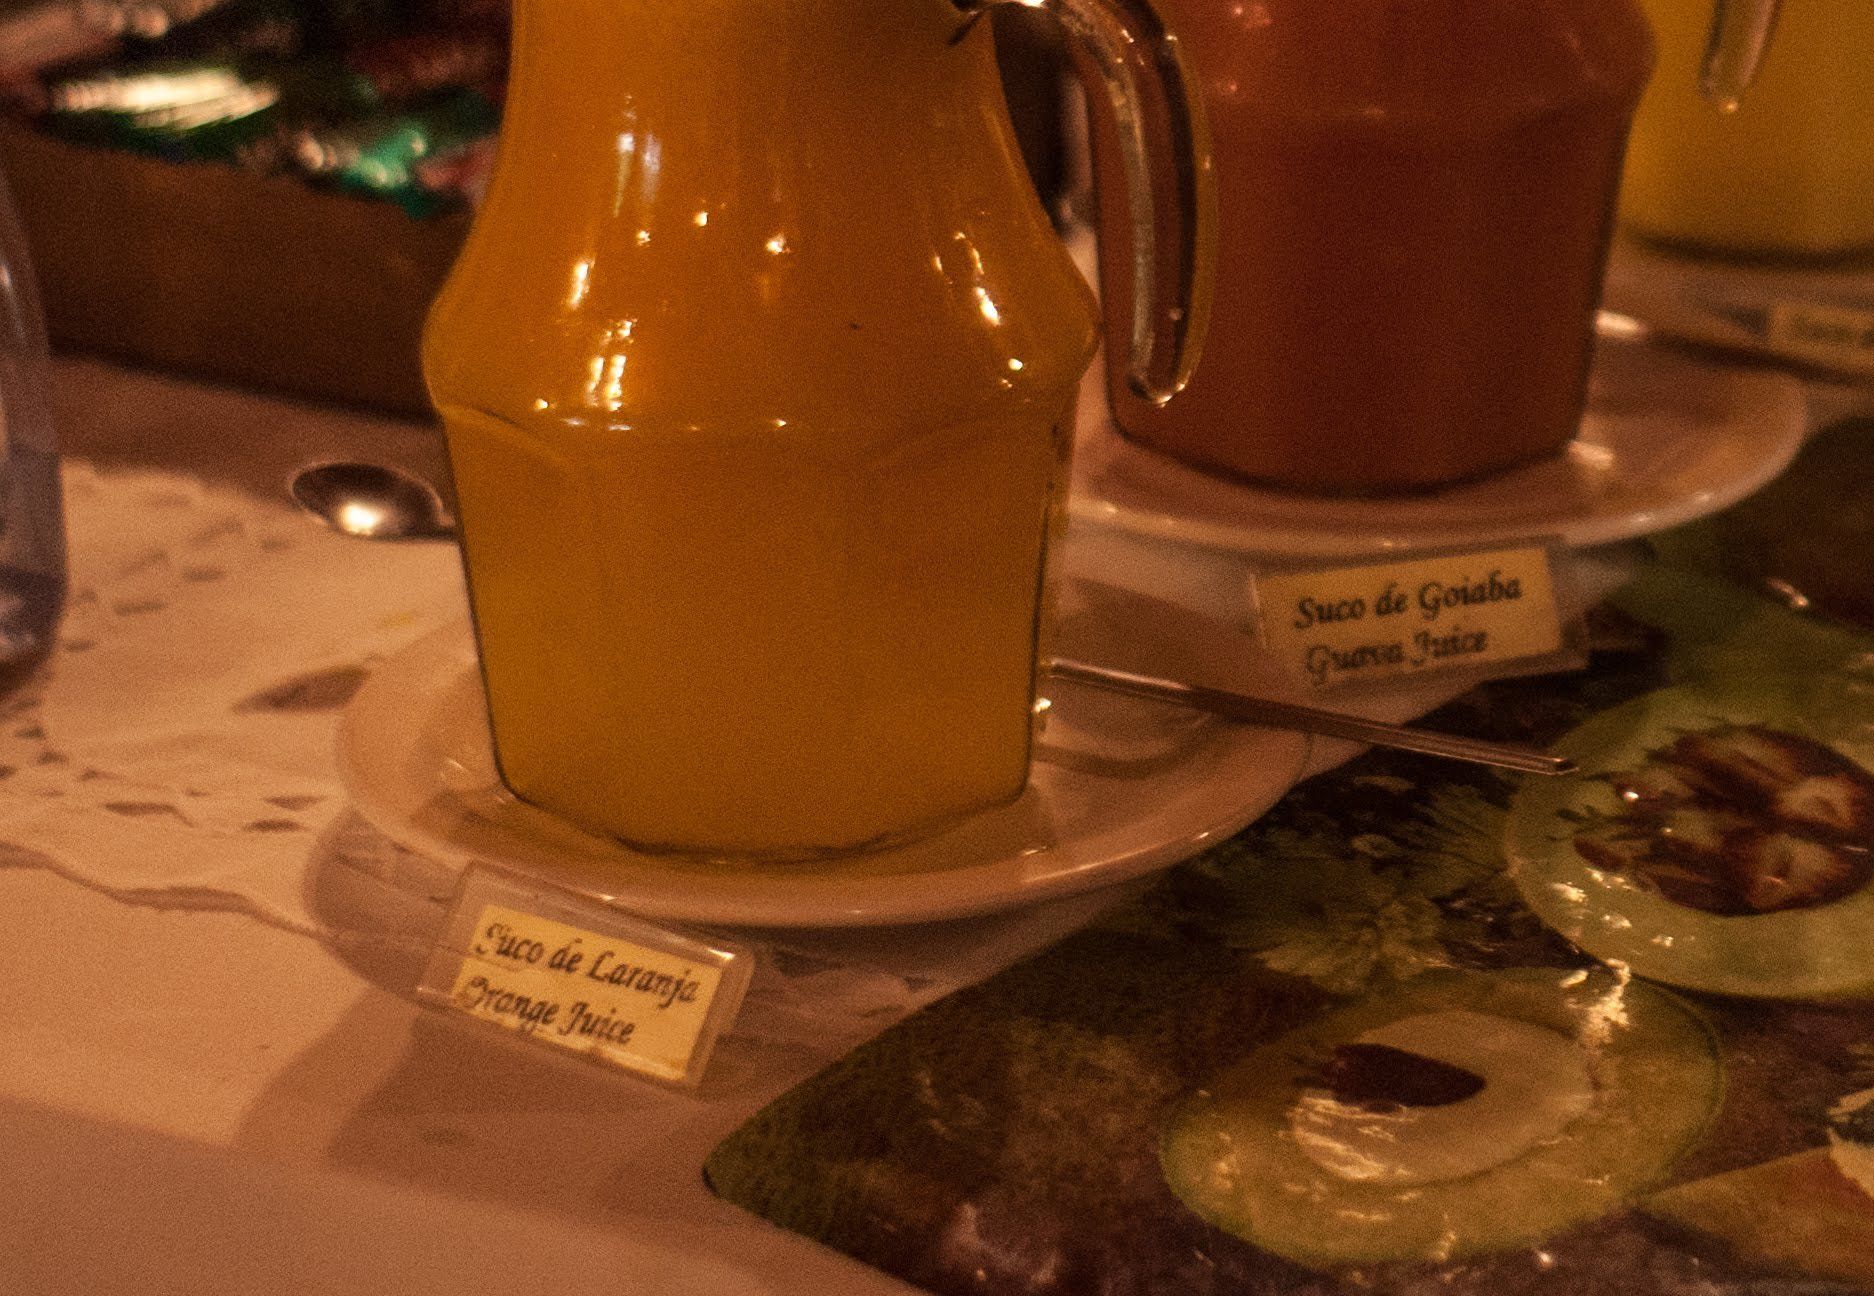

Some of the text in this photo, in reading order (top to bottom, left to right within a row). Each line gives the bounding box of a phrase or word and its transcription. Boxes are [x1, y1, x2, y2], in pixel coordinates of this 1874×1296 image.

[1294, 569, 1522, 630] Suco de Goiaba
[1305, 624, 1488, 686] Guava Juice
[475, 922, 700, 1009] Suco de Laranja
[463, 975, 636, 1045] Orange Juice
